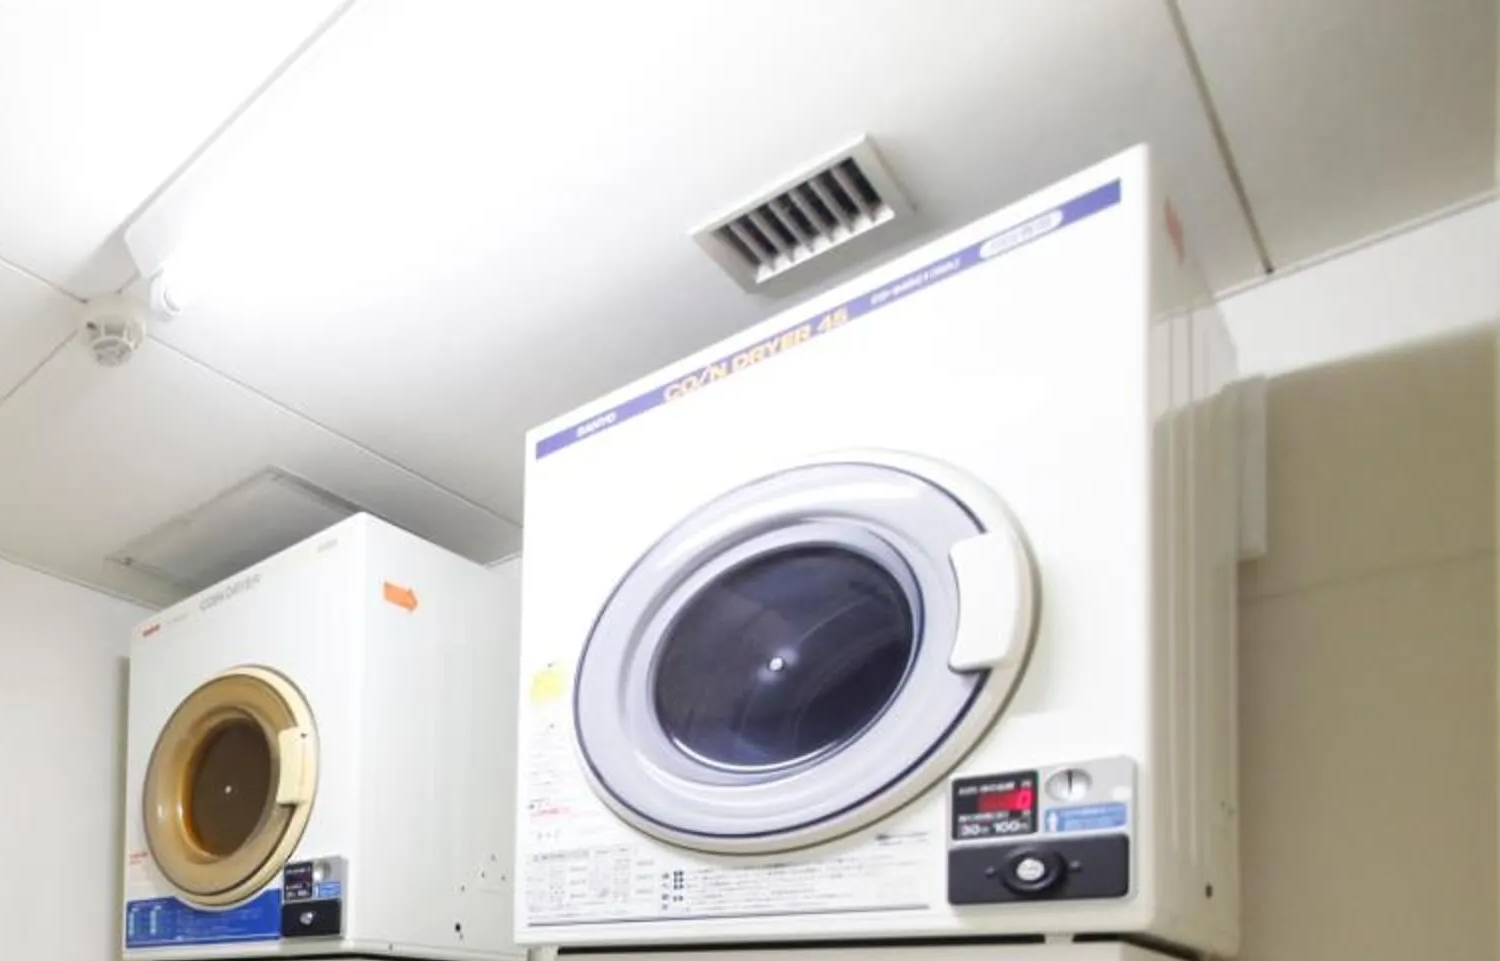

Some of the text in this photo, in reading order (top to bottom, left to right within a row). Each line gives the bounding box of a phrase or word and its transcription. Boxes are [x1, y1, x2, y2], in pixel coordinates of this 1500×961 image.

[731, 323, 812, 373] DRYER
[816, 306, 848, 333] 45
[576, 411, 618, 438] SANYO
